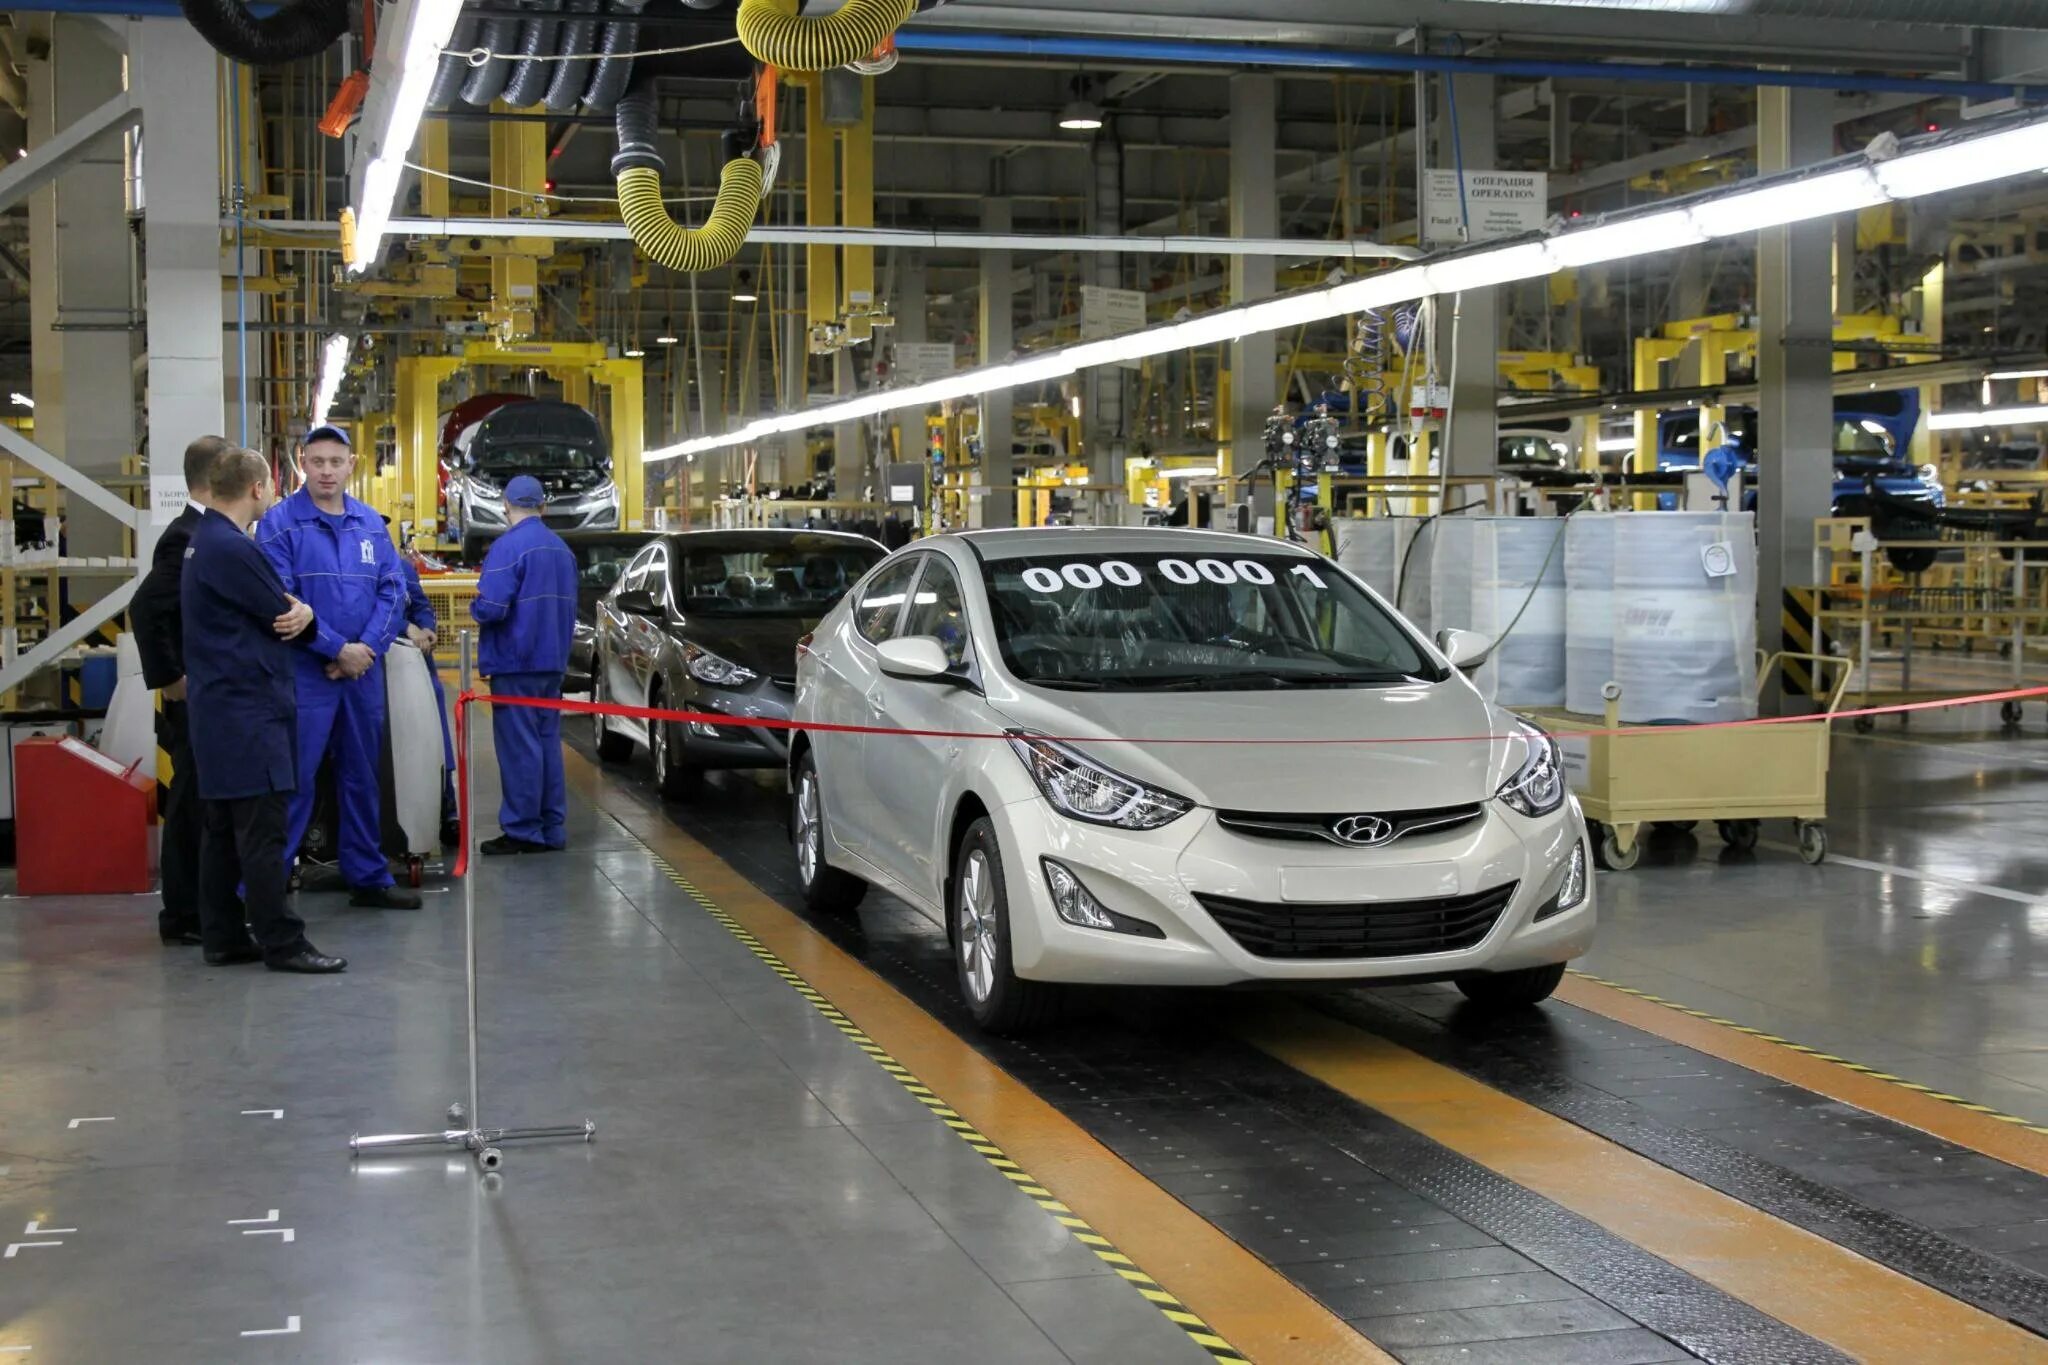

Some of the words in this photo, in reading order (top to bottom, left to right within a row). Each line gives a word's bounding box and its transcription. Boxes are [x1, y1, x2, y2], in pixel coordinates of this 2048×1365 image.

[1472, 176, 1534, 187] ОПЕРАЦИЯ
[1471, 189, 1535, 198] OPERATION
[158, 490, 189, 498] УБОРО
[1021, 560, 1142, 593] 000
[1157, 559, 1275, 585] 000
[1289, 564, 1328, 589] 1
